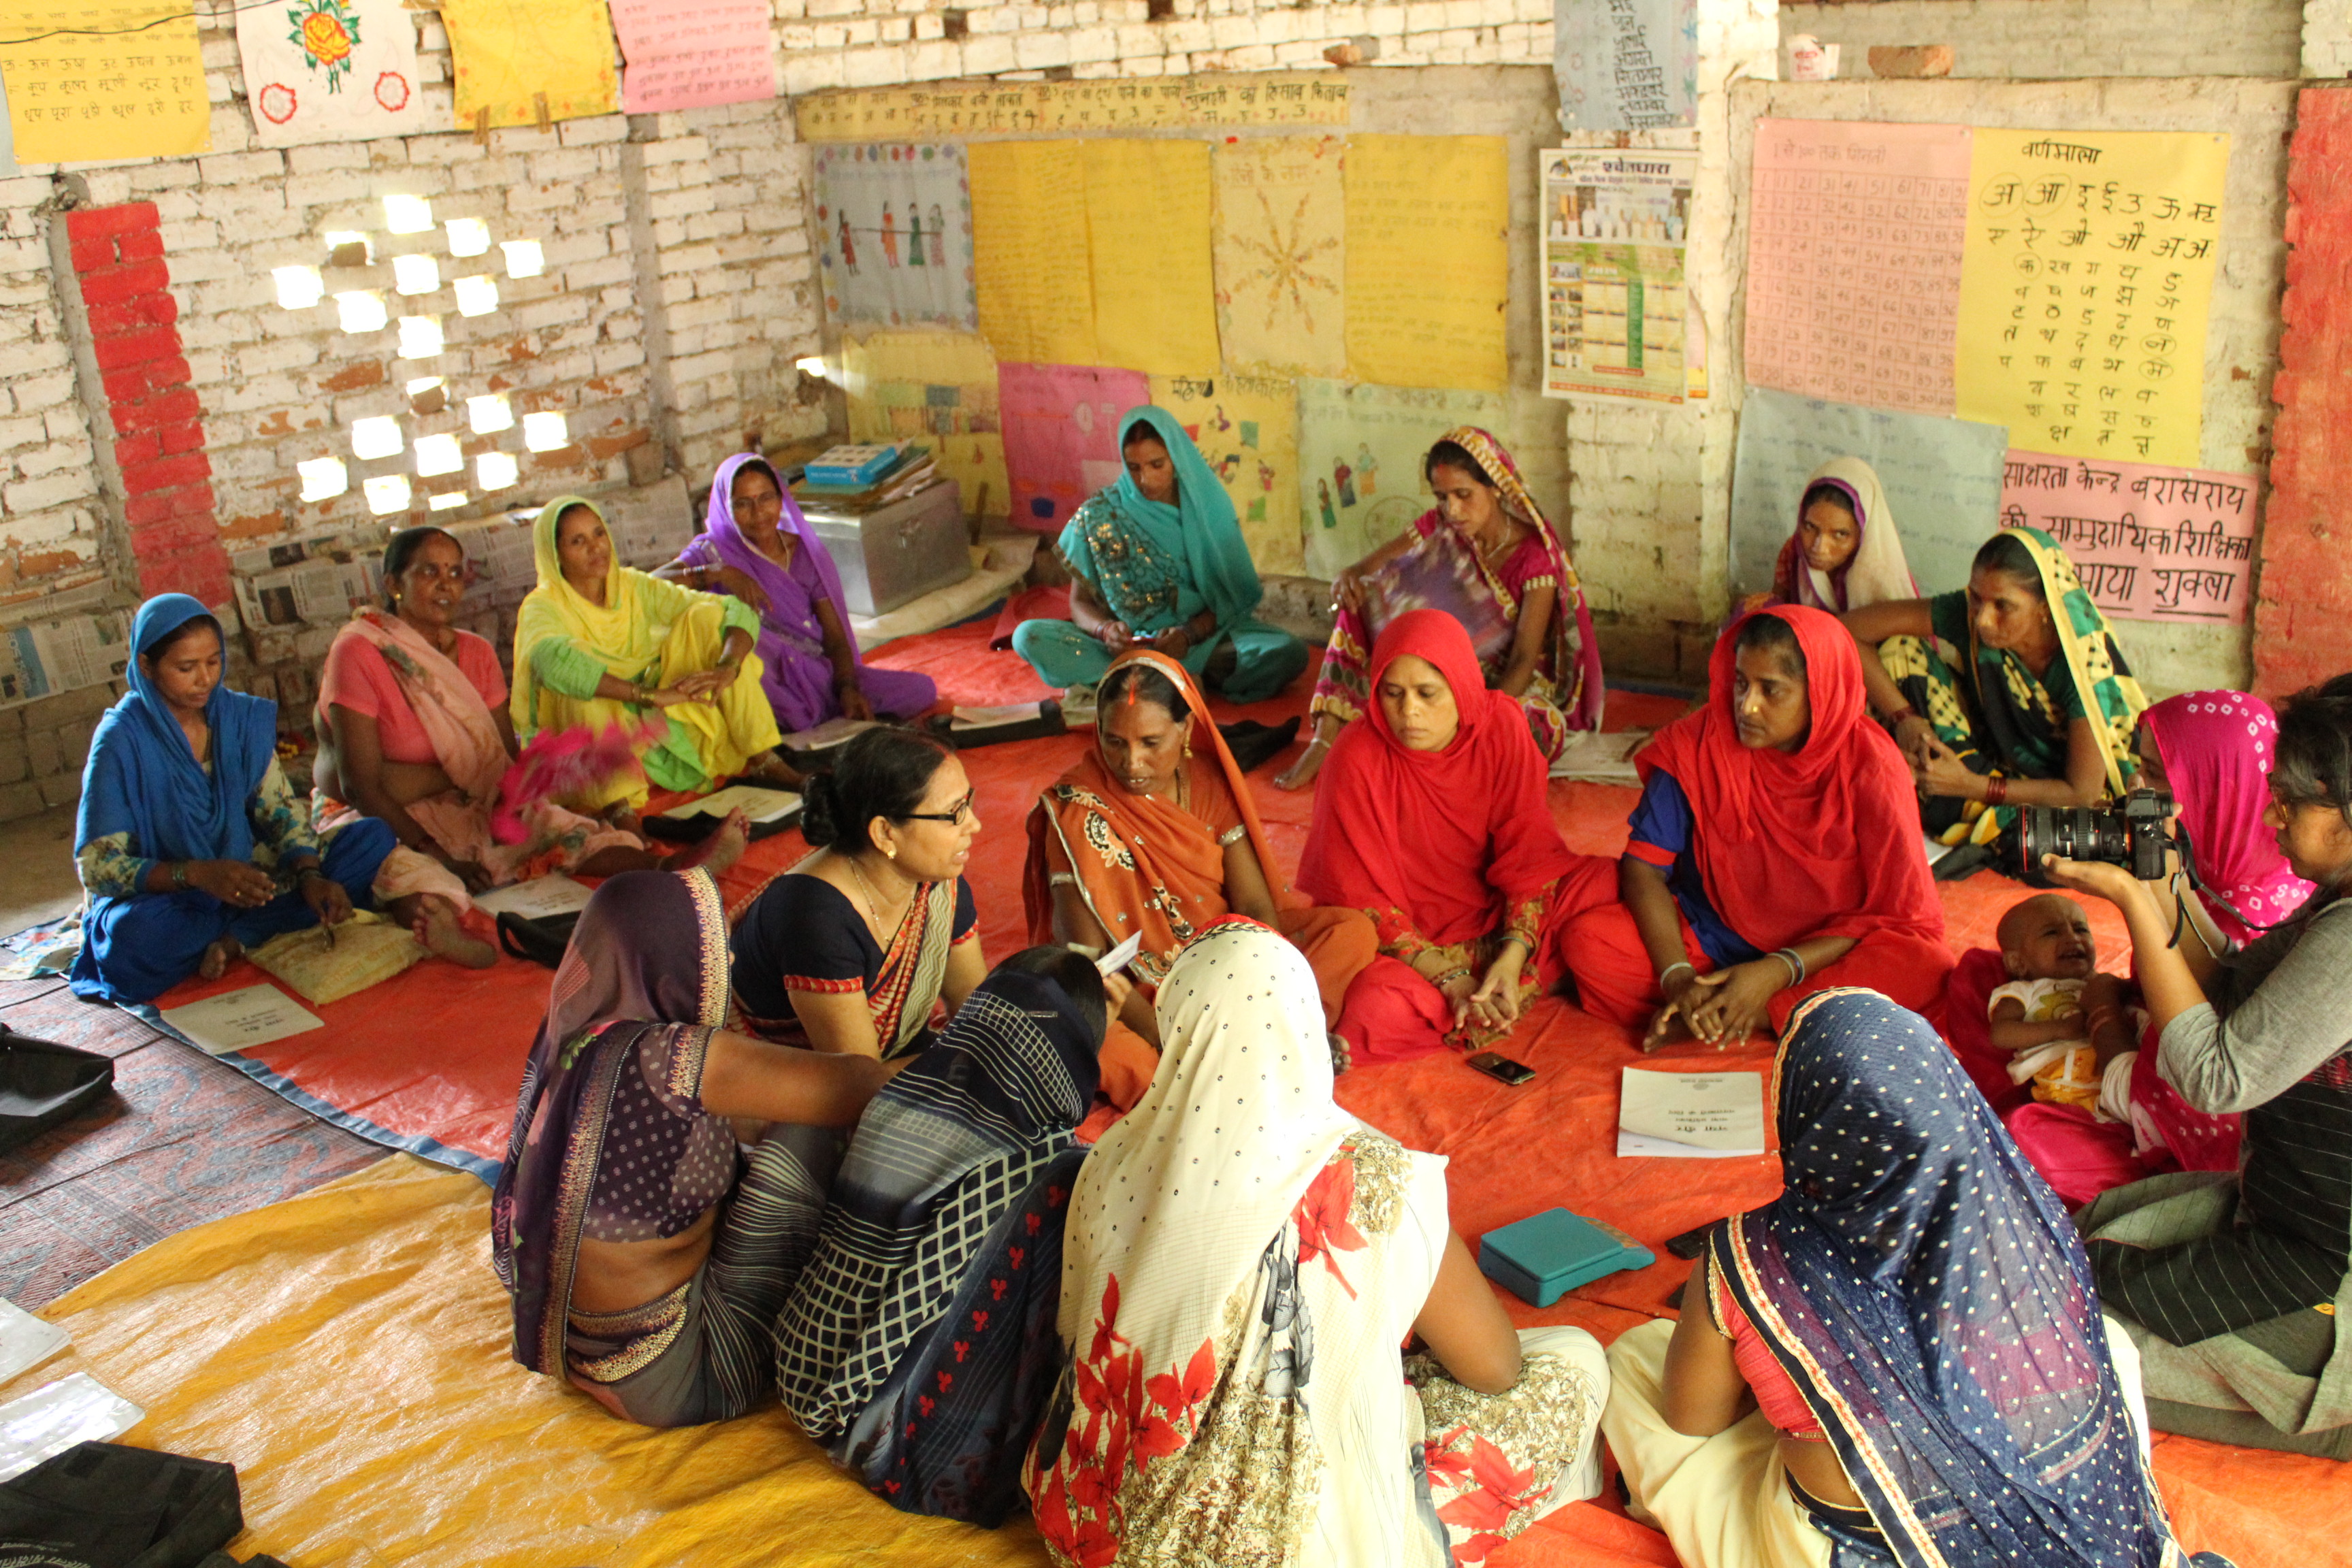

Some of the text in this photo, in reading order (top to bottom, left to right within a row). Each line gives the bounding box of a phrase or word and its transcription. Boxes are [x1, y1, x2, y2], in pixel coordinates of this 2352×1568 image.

[2022, 138, 2103, 164] वर्णमाला
[1799, 176, 1812, 190] 21
[1824, 178, 1835, 191] 31
[1844, 178, 1859, 193] 41
[1871, 180, 1885, 195] 51
[1897, 180, 1912, 194] 61
[1920, 182, 1931, 197] 71
[1938, 183, 1950, 197] 81
[1955, 185, 1967, 201] 91
[1983, 183, 2021, 205] अ
[2025, 182, 2065, 206] आ
[2078, 184, 2095, 212] इ
[2102, 181, 2119, 214] ई
[2119, 193, 2144, 214] उ
[2151, 196, 2181, 221] ऊ
[1757, 195, 1765, 208] 2
[1796, 197, 1811, 211] 22
[1822, 198, 1835, 213] 32
[1841, 201, 1855, 214] 42
[1867, 204, 1884, 217] 52
[1894, 204, 1909, 220] 62
[1916, 207, 1930, 220] 72
[1953, 207, 1966, 218] 92
[1792, 219, 1810, 231] 23
[1820, 221, 1835, 236] 33
[1842, 223, 1857, 235] 43
[1867, 227, 1882, 240] 53
[1892, 228, 1908, 243] 63
[1914, 229, 1929, 243] 73
[1934, 230, 1947, 243] 83
[1951, 230, 1964, 243] 93
[1988, 228, 2010, 245] ए
[2021, 217, 2046, 249] ऐ
[2058, 218, 2092, 247] ओ
[2108, 221, 2146, 252] औ
[1817, 244, 1833, 257] 34
[1841, 246, 1857, 258] 44
[1865, 250, 1880, 263] 54
[1890, 252, 1906, 266] 64
[1911, 255, 1925, 267] 74
[2019, 259, 2034, 274] क
[2049, 260, 2071, 275] ख
[2086, 261, 2101, 276] ग
[1754, 261, 1961, 294] 5 25 35 45 55 65 75 85 95
[2080, 285, 2097, 299] ज
[2012, 305, 2025, 320] ट
[2046, 304, 2061, 320] ठ
[2080, 308, 2095, 325] ड
[2155, 316, 2175, 331] ण
[2004, 325, 2019, 342] त
[2076, 331, 2090, 353] द
[1999, 355, 2170, 378] प फ ब भ म
[1786, 373, 1910, 402] 30 50 60 70 80
[2063, 382, 2082, 399] र
[2136, 389, 2159, 404] व
[2100, 410, 2121, 425] स
[2003, 461, 2069, 489] साक्षरता
[2076, 460, 2122, 494] केन्द्र
[2001, 504, 2027, 527] की
[2152, 569, 2236, 608] शुक्ला
